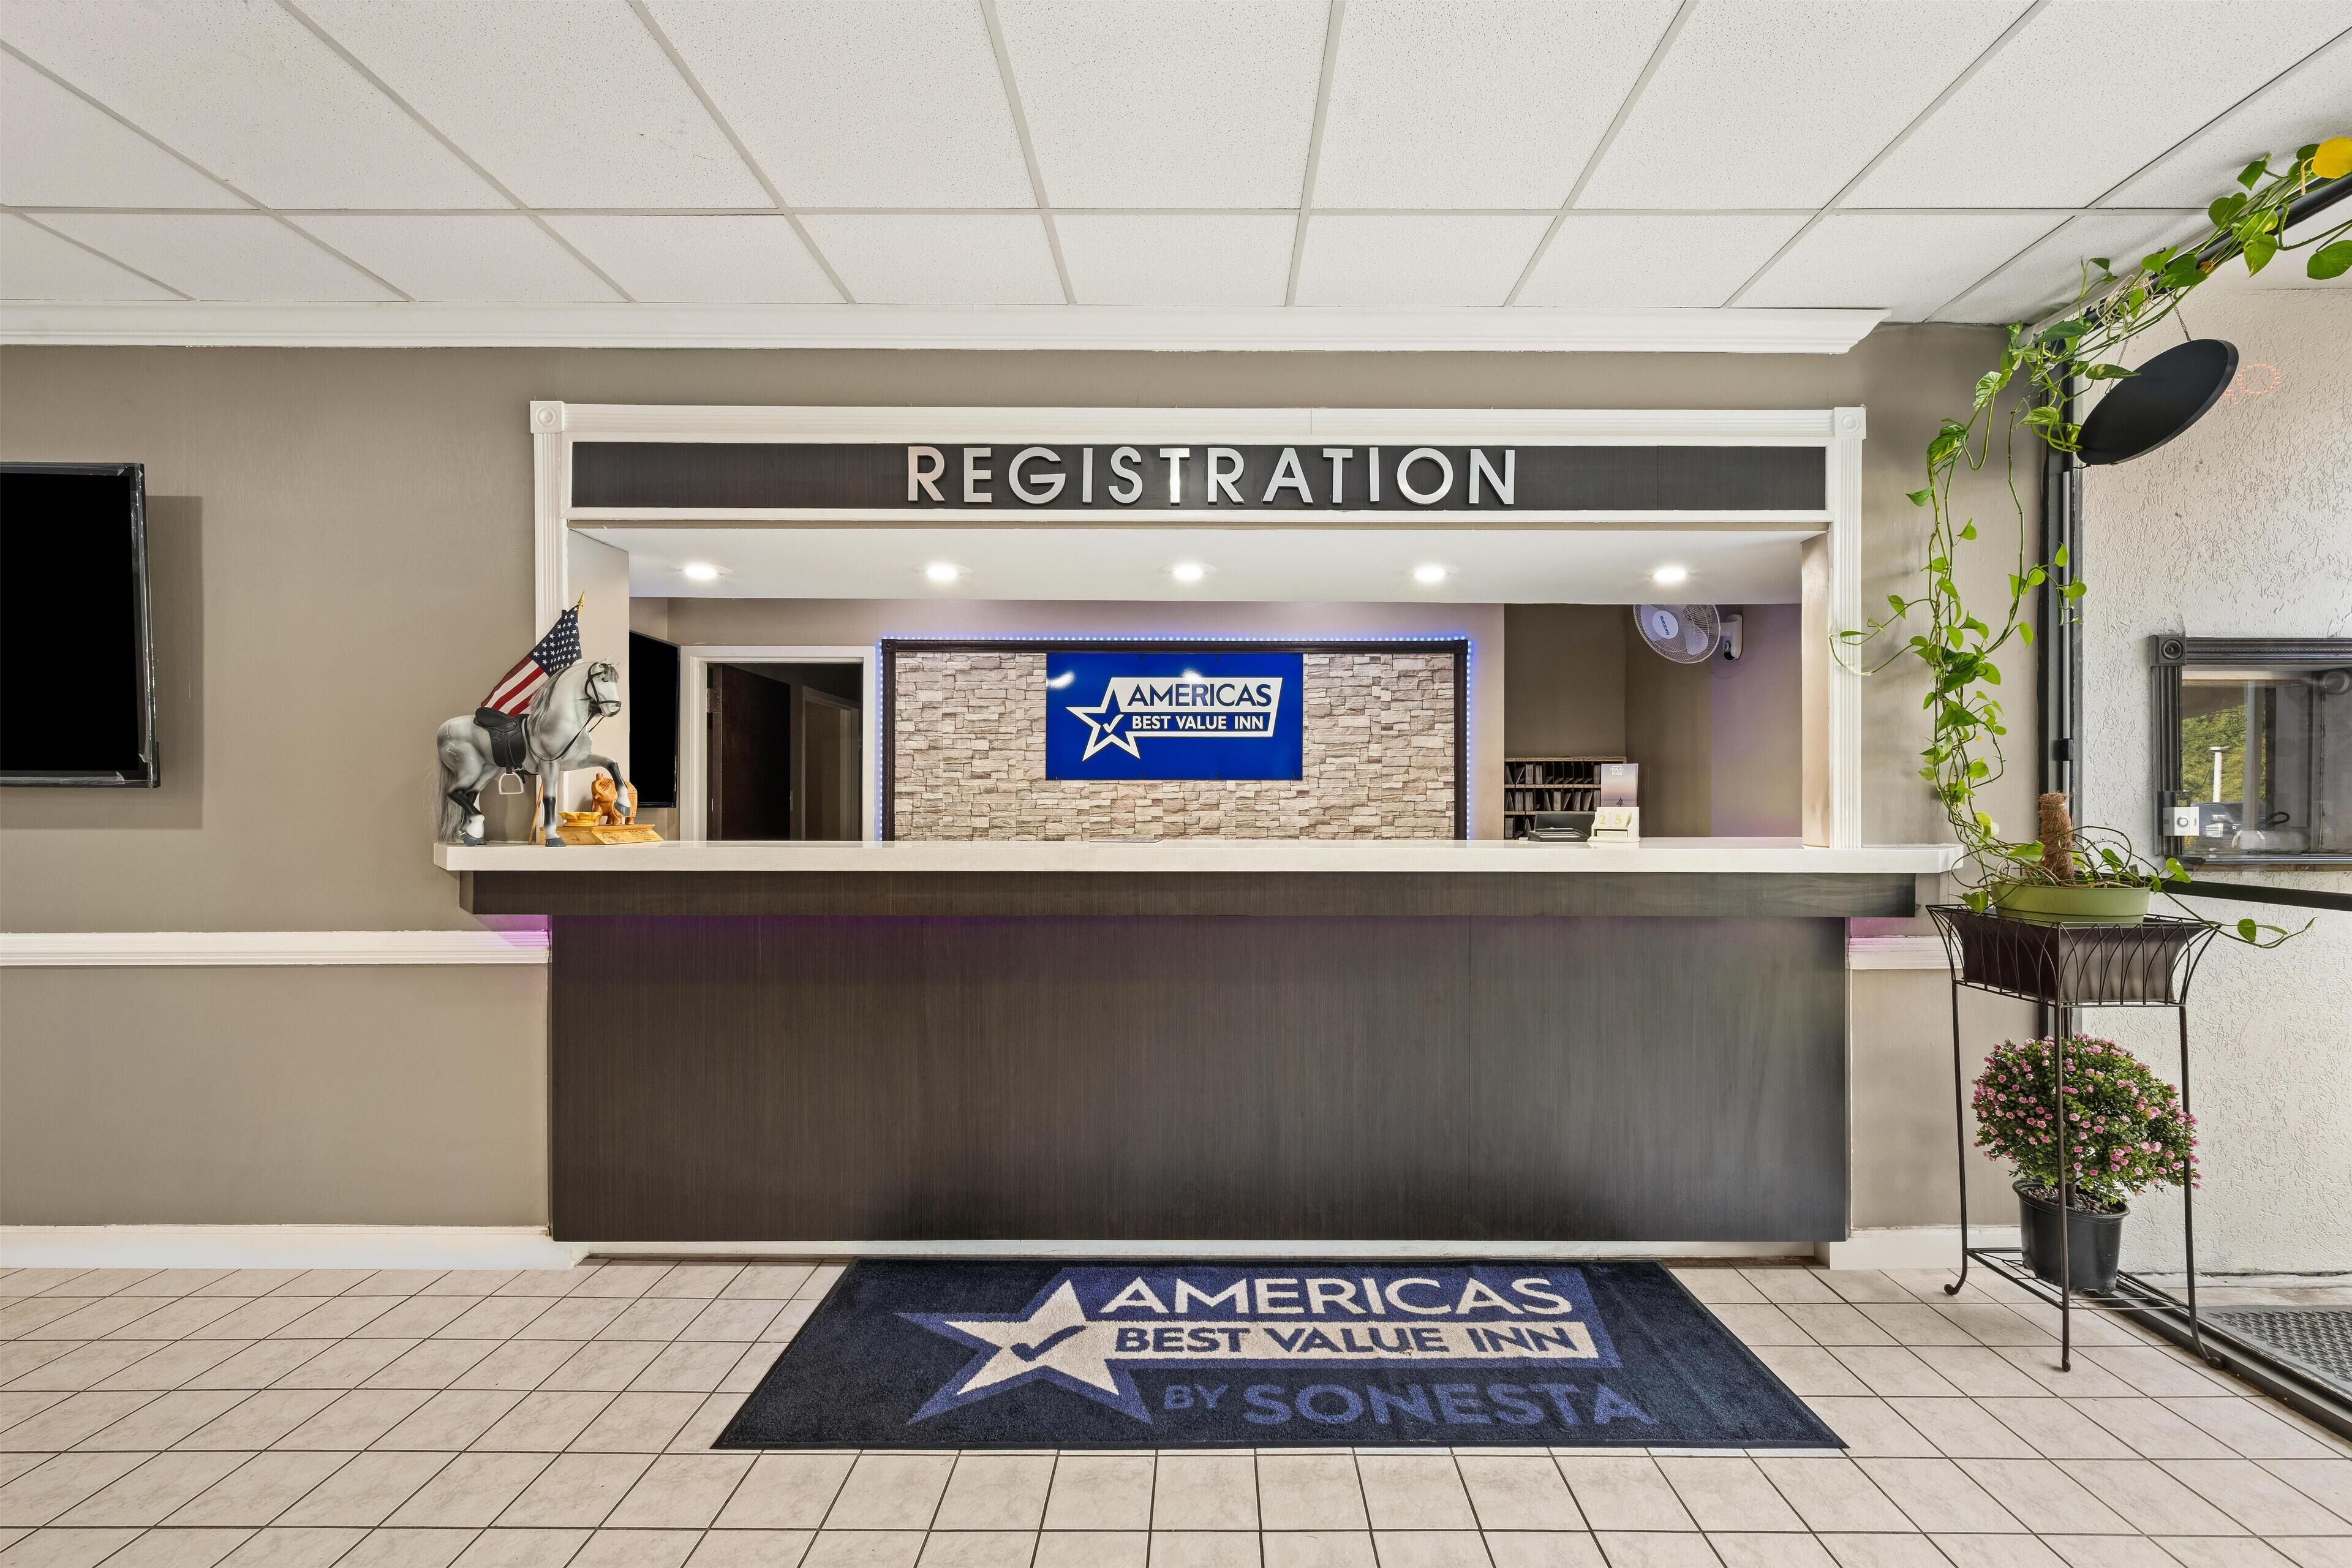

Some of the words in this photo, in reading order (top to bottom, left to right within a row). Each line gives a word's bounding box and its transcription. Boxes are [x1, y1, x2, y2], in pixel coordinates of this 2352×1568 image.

[907, 446, 1515, 505] REGISTRATION
[1127, 683, 1272, 707] AMERICAS
[1132, 715, 1171, 729] BEST
[1175, 715, 1227, 729] VALUE
[1234, 715, 1264, 729] INN
[1099, 1276, 1572, 1314] AMERICAS
[1115, 1327, 1250, 1353] BEST
[1263, 1327, 1447, 1353] VALUE
[1466, 1327, 1578, 1352] INN
[1164, 1383, 1229, 1409] BY
[1243, 1382, 1657, 1425] SONESTA
